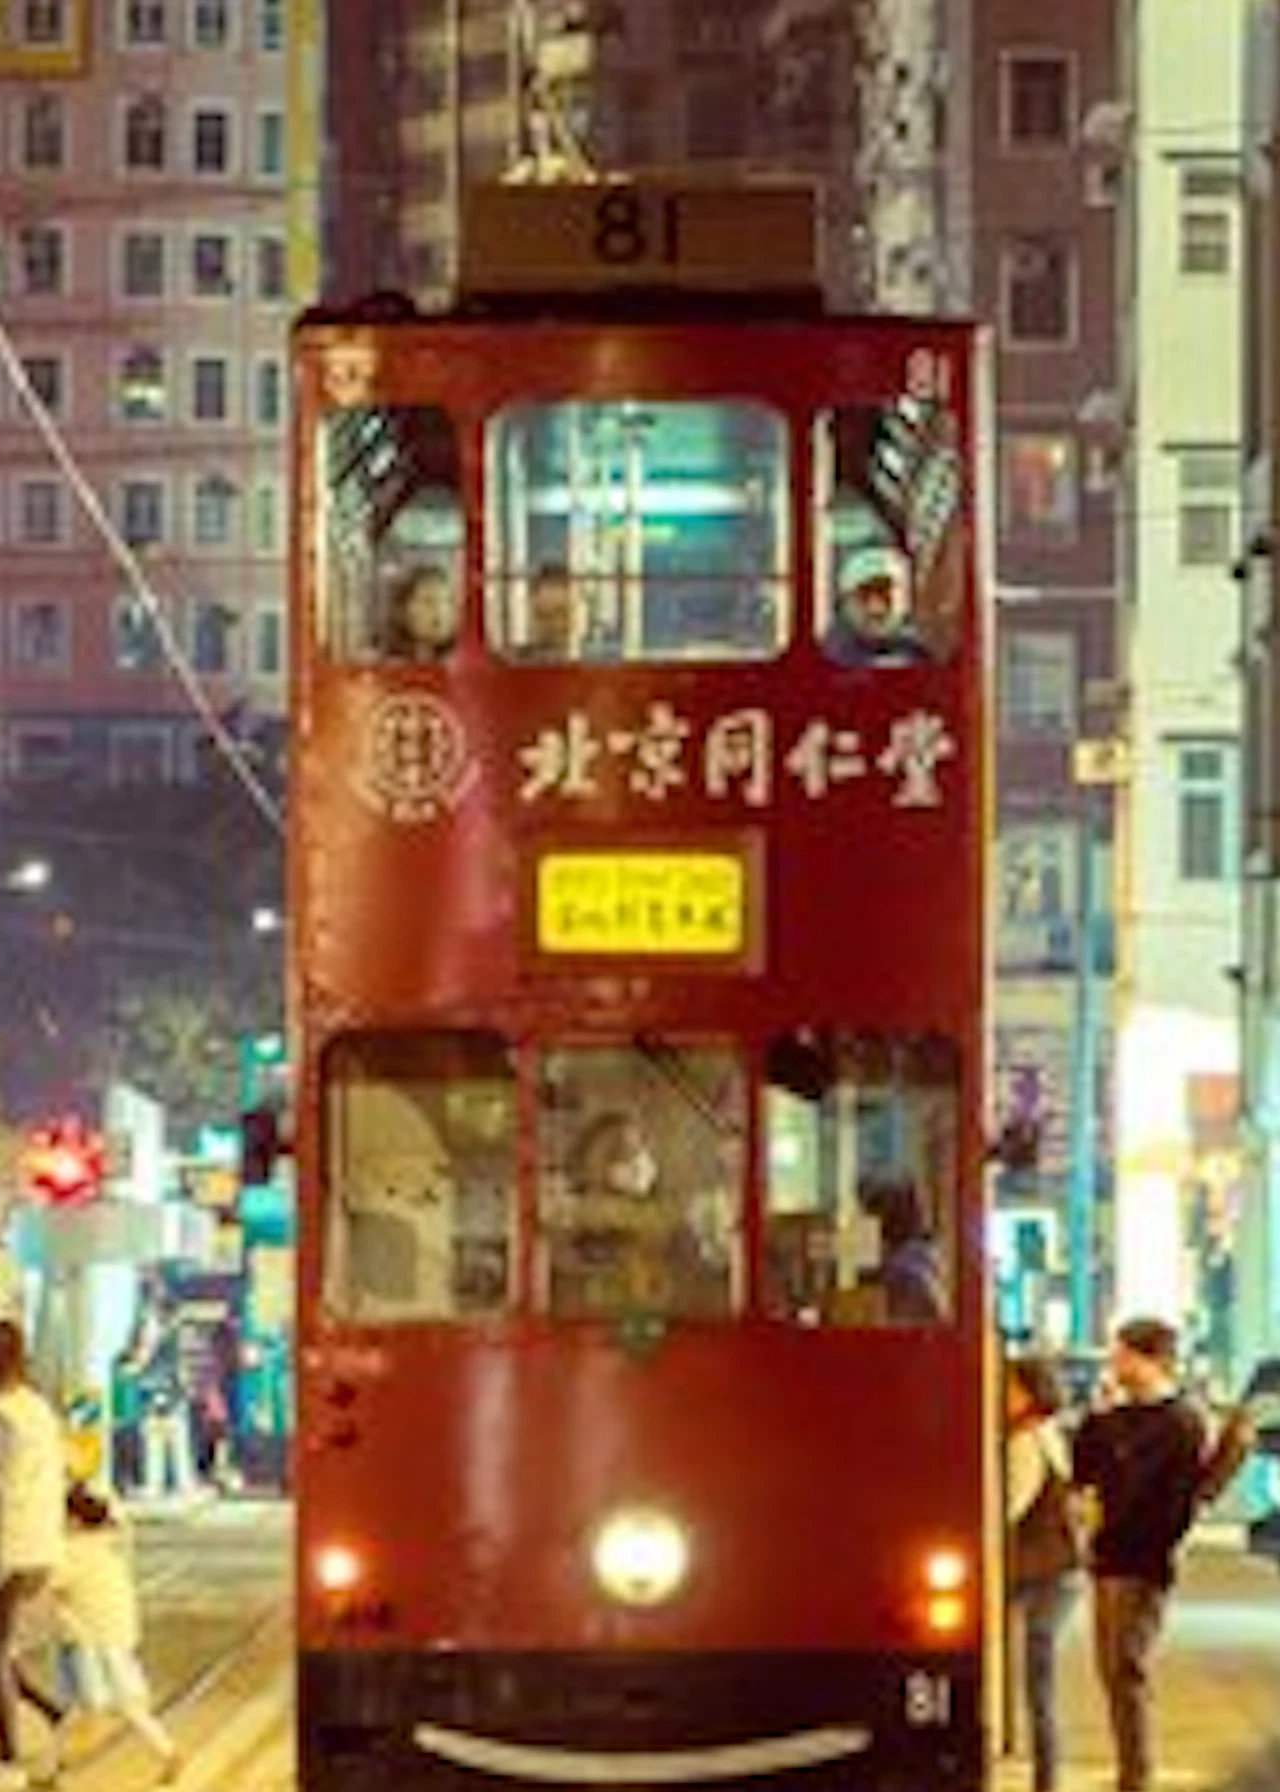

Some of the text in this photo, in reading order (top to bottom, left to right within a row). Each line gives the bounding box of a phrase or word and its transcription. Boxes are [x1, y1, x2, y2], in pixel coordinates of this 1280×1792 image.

[593, 191, 680, 266] 81
[518, 702, 957, 808] 北京同仁堂
